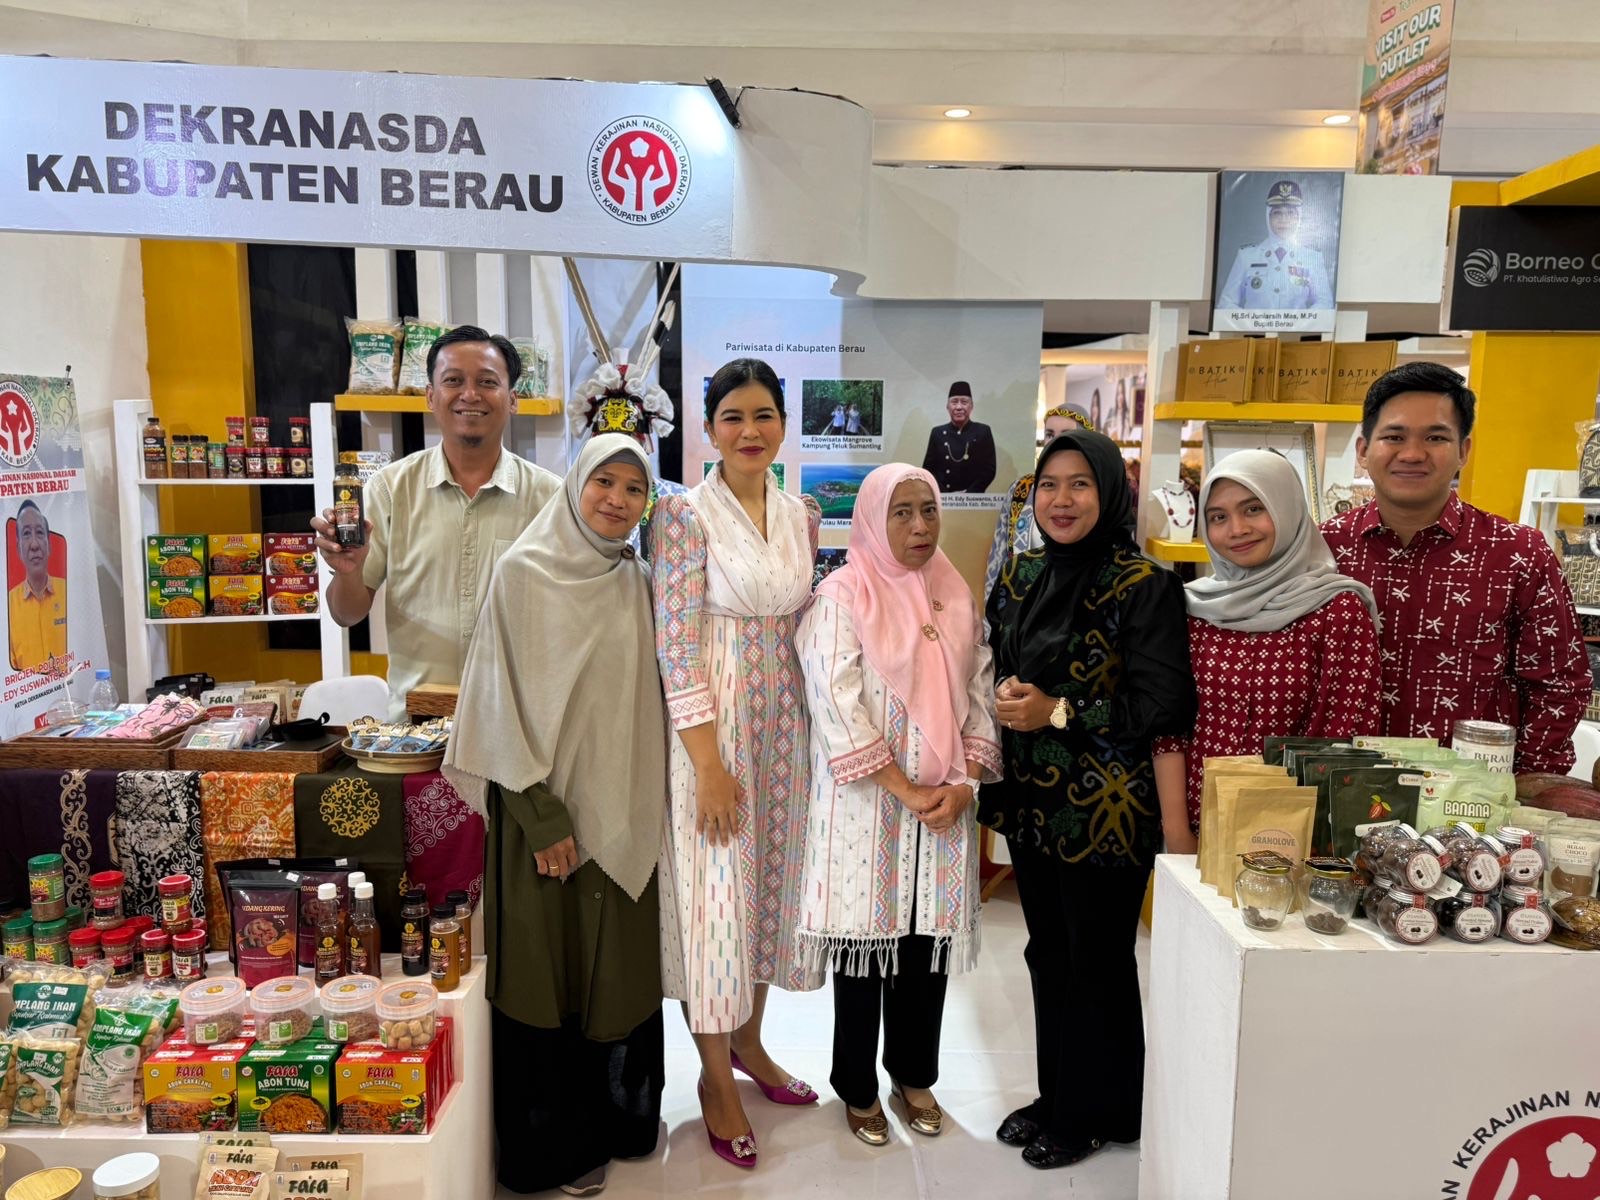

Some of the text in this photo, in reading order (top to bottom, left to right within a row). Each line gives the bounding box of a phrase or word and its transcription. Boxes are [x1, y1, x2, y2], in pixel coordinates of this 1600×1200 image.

[1376, 20, 1408, 58] VISIT
[1409, 4, 1441, 37] OUR
[1380, 35, 1430, 80] OUTLET
[105, 101, 486, 156] DEKRANASDA
[591, 120, 689, 196] DEWAN KERAJINAN NASIONAL DAERAH
[27, 154, 563, 213] KABUPATEN BERAU
[603, 197, 676, 222] KABUPATEN BERAU
[1505, 252, 1585, 270] Borneo
[1518, 274, 1569, 283] Khatulistiwa
[1571, 274, 1591, 285] Agro
[725, 342, 866, 354] Pariwisata di Kabupaten Berau
[1198, 365, 1236, 375] BATIK
[1278, 367, 1318, 377] BATIK
[1337, 368, 1379, 377] BATIK
[842, 436, 873, 444] Mangrove
[849, 443, 882, 451] Sumanting
[22, 471, 53, 480] NASIONAL
[36, 479, 70, 493] BERAU
[4, 688, 19, 702] EDY
[1444, 800, 1491, 818] BANANA
[1251, 836, 1296, 847] GRANOLOVE
[52, 1001, 76, 1012] IKAN
[258, 1078, 282, 1090] ABON
[284, 1078, 309, 1089] TUNA
[1452, 1090, 1570, 1169] KERAJINAN
